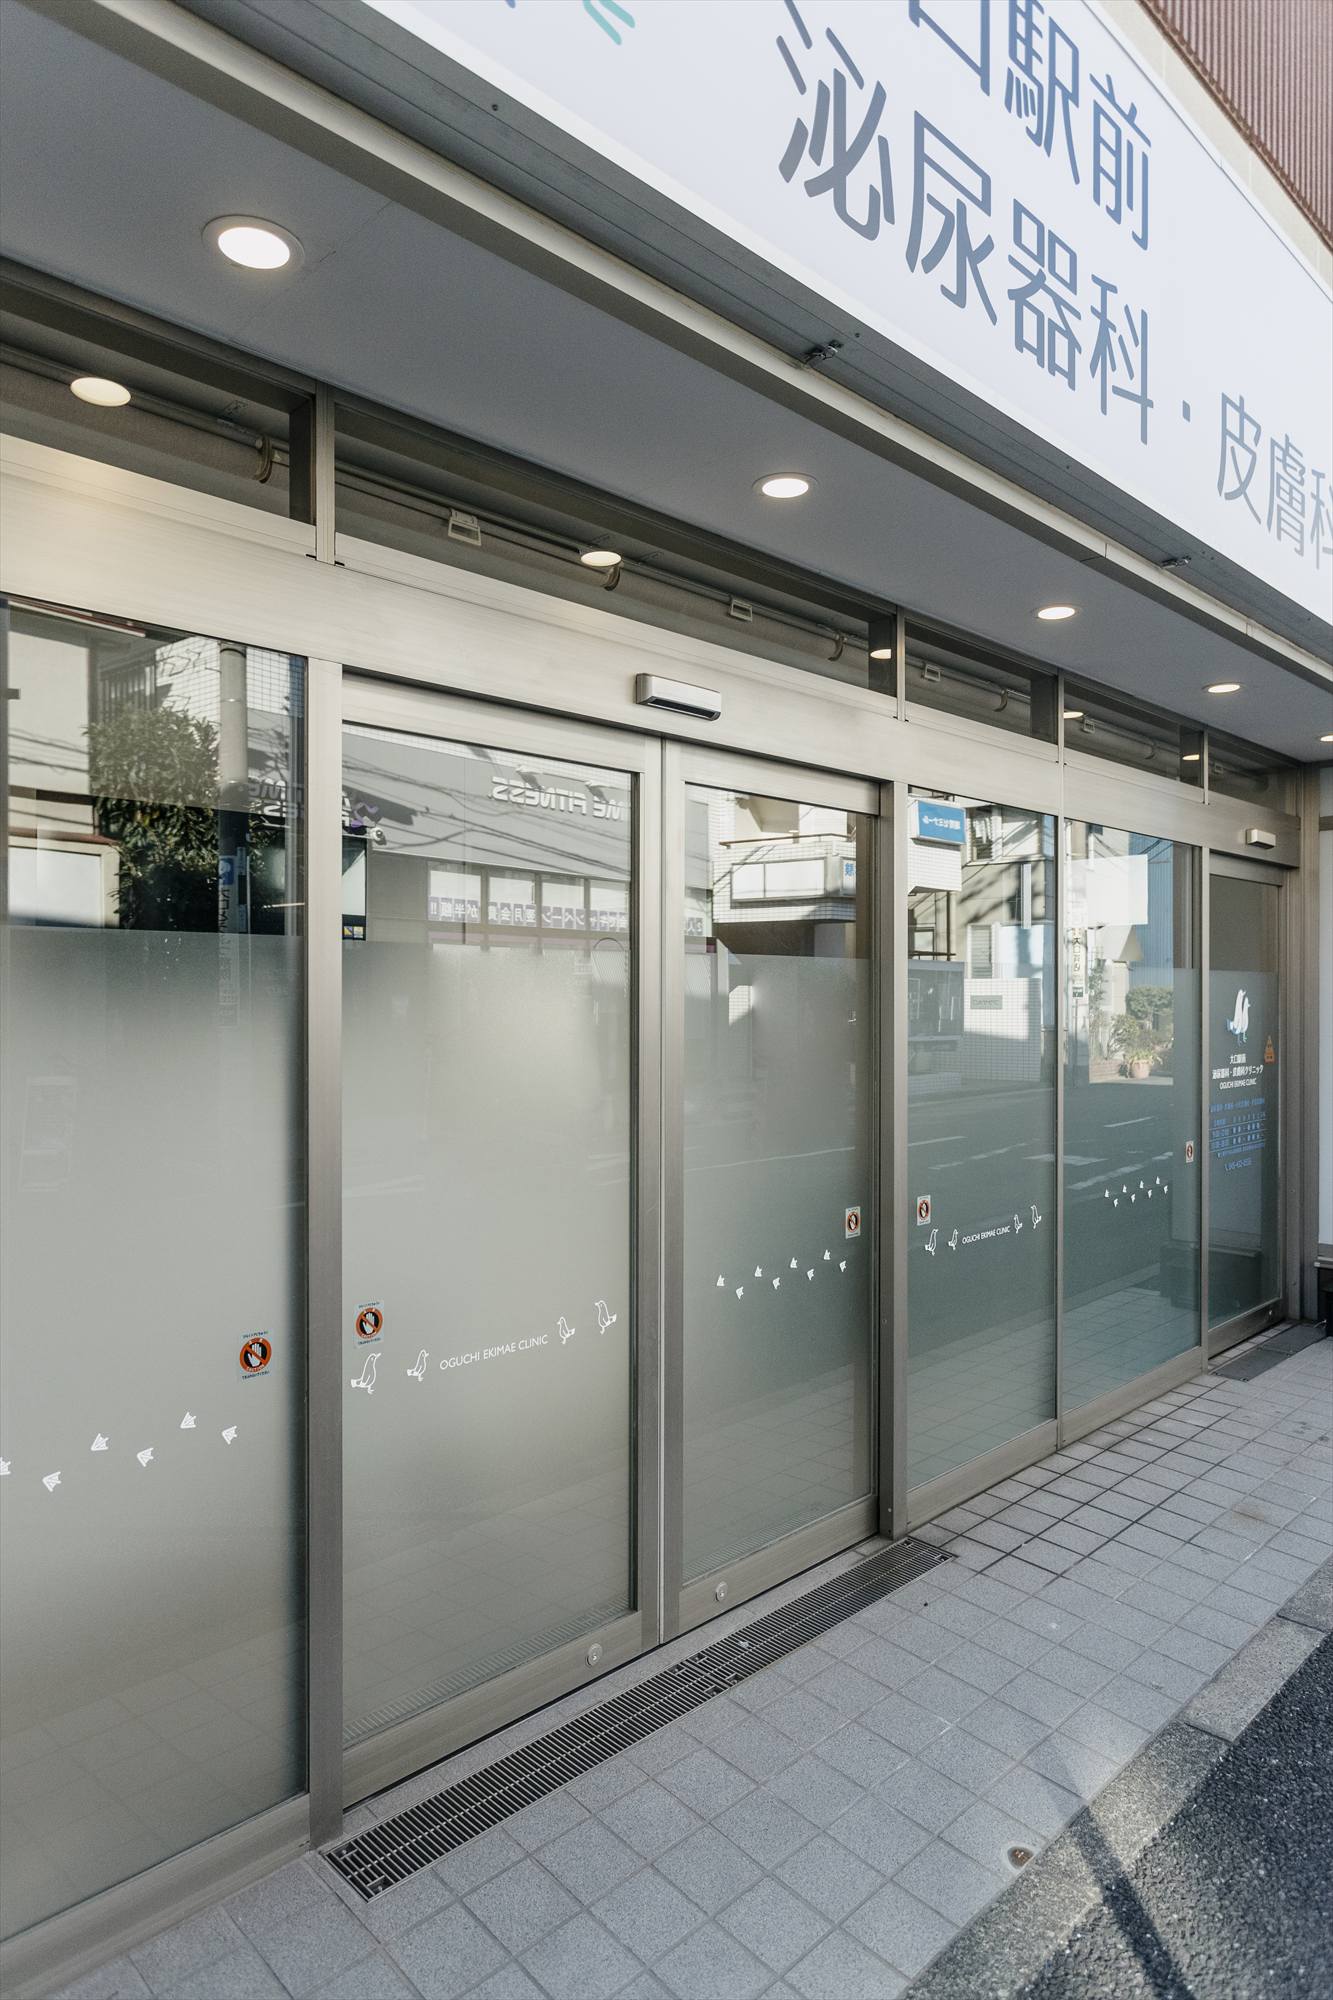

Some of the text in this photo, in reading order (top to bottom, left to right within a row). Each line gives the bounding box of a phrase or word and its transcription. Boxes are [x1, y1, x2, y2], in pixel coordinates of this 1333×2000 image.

[962, 1233, 980, 1244] OGUCHI
[996, 1226, 1010, 1235] CLINIC
[440, 1334, 549, 1370] OGUCHI EKIMAE CLINIC
